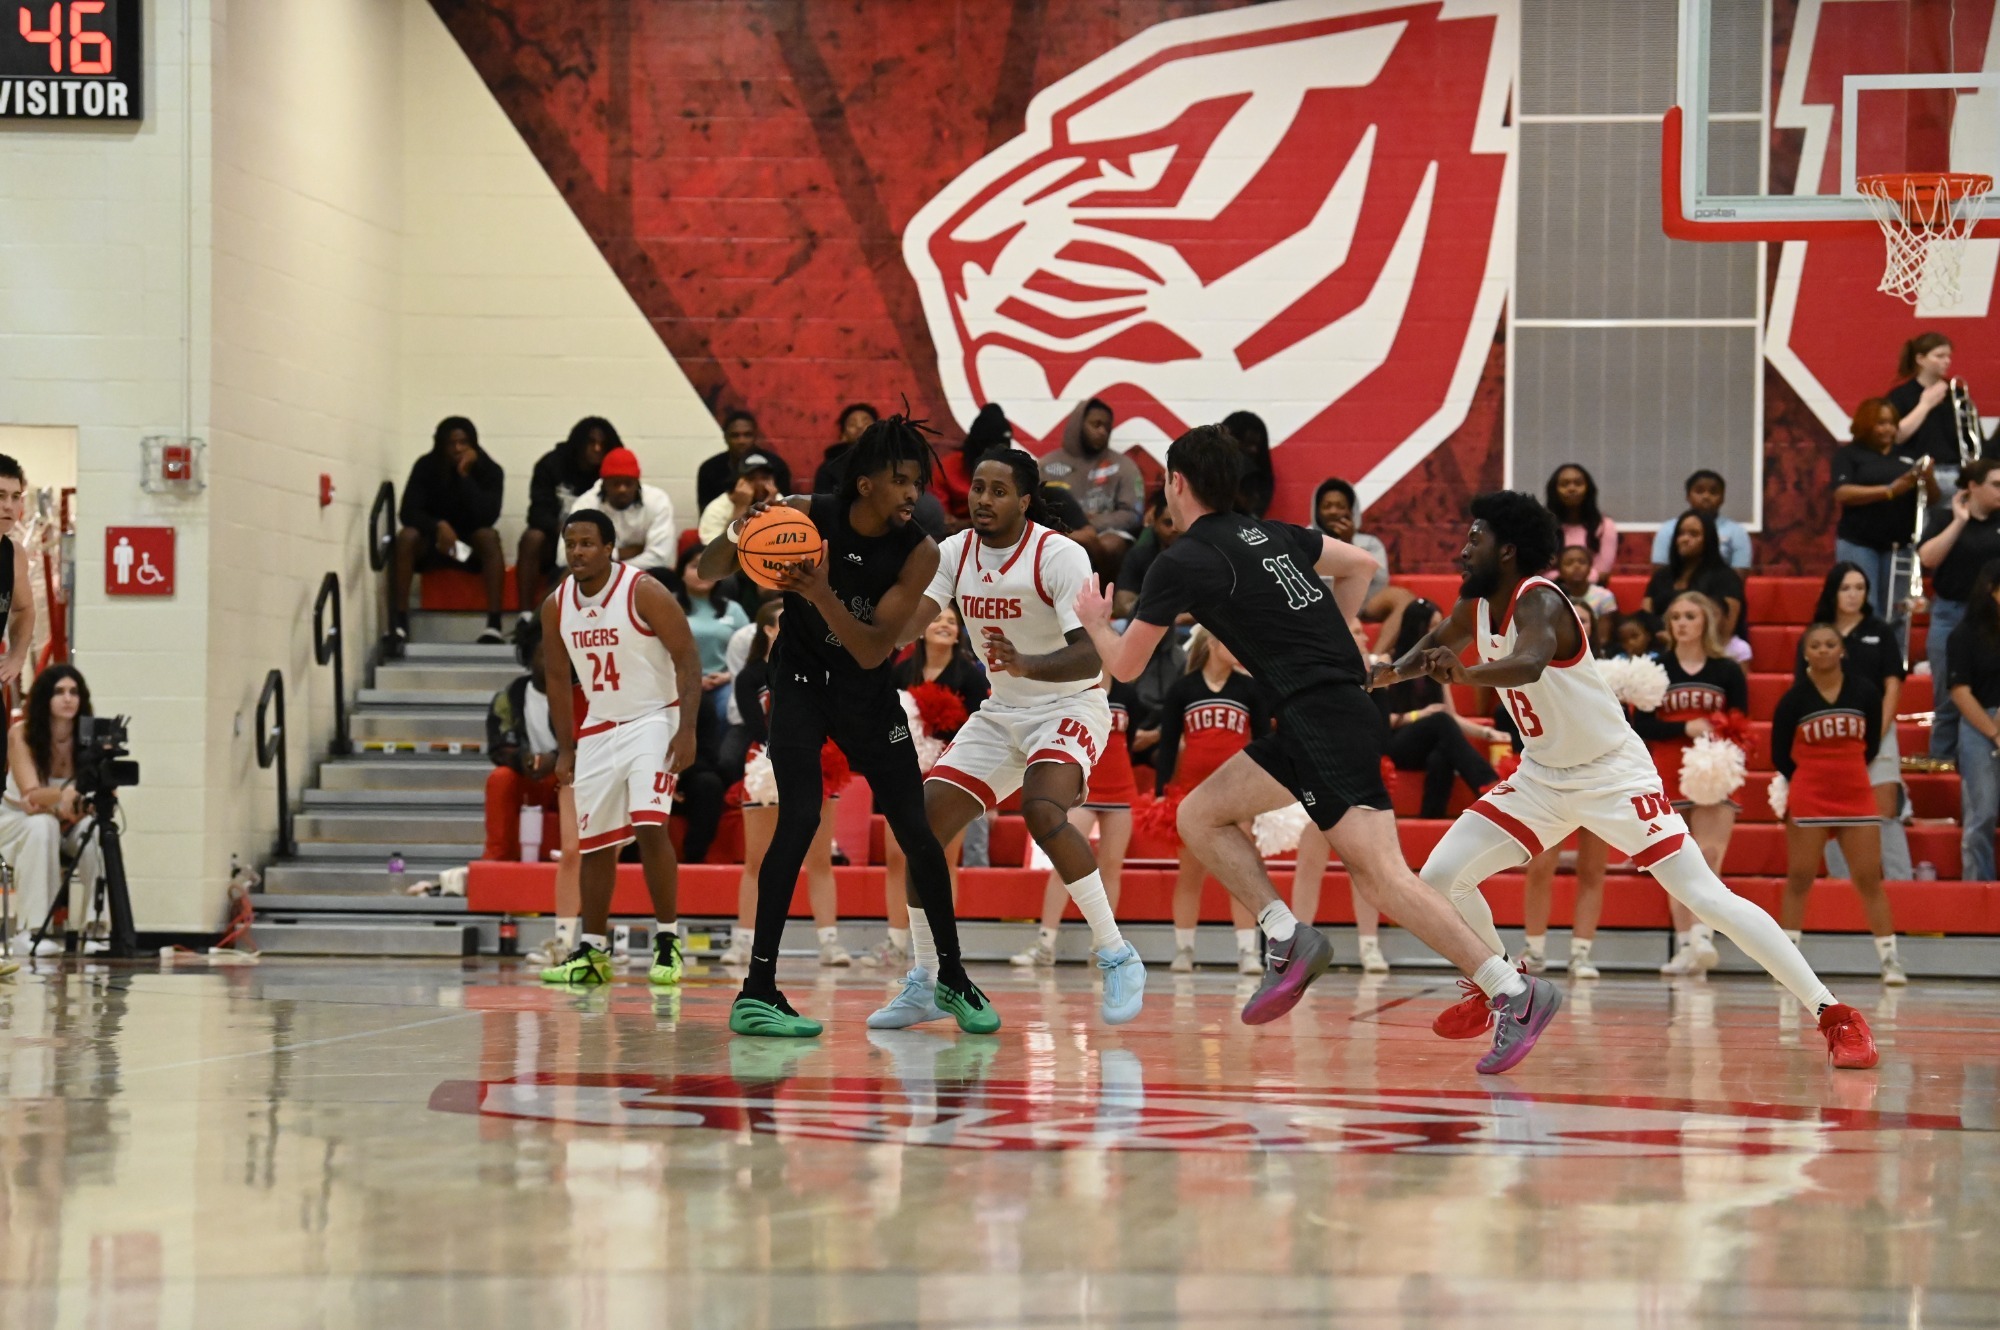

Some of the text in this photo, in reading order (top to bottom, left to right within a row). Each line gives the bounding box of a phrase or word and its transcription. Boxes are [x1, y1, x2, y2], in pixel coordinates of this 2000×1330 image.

[19, 1, 112, 74] 46
[0, 80, 129, 116] VISITOR
[776, 532, 807, 544] EVO
[1262, 553, 1323, 610] 11
[961, 594, 1022, 620] TIGERS
[571, 627, 619, 649] TIGERS
[586, 651, 621, 692] 24
[1184, 708, 1247, 735] TIGERS
[1506, 688, 1543, 737] 13
[1802, 716, 1867, 744] TIGERS
